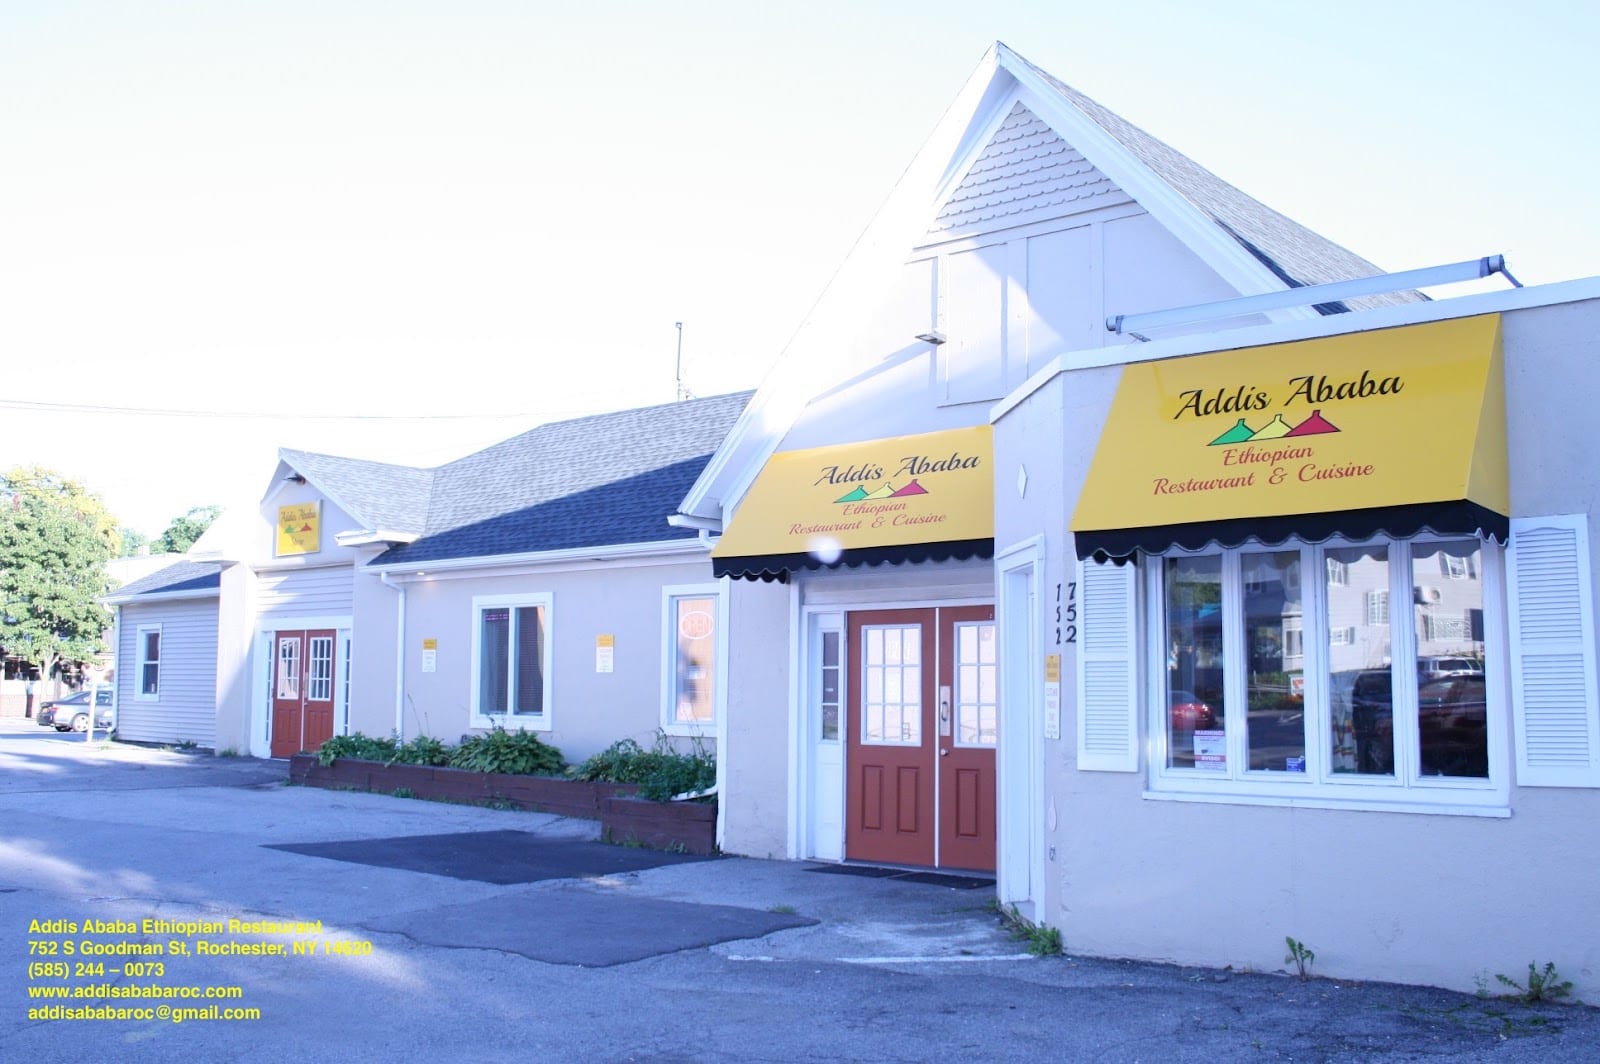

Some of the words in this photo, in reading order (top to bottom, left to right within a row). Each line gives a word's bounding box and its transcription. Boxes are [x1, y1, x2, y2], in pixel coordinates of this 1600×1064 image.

[1174, 385, 1272, 419] Addis
[1284, 370, 1404, 406] Ababa
[814, 463, 885, 486] Addis
[893, 452, 981, 477] Ababa
[1223, 445, 1313, 467] Ethiopian
[1153, 472, 1255, 495] Restaurant
[1268, 467, 1287, 484] &
[1298, 462, 1375, 481] Cuisine
[843, 501, 907, 517] Ethiopian
[789, 520, 862, 535] Restaurant
[871, 516, 885, 528] &
[892, 513, 947, 527] Cuisine
